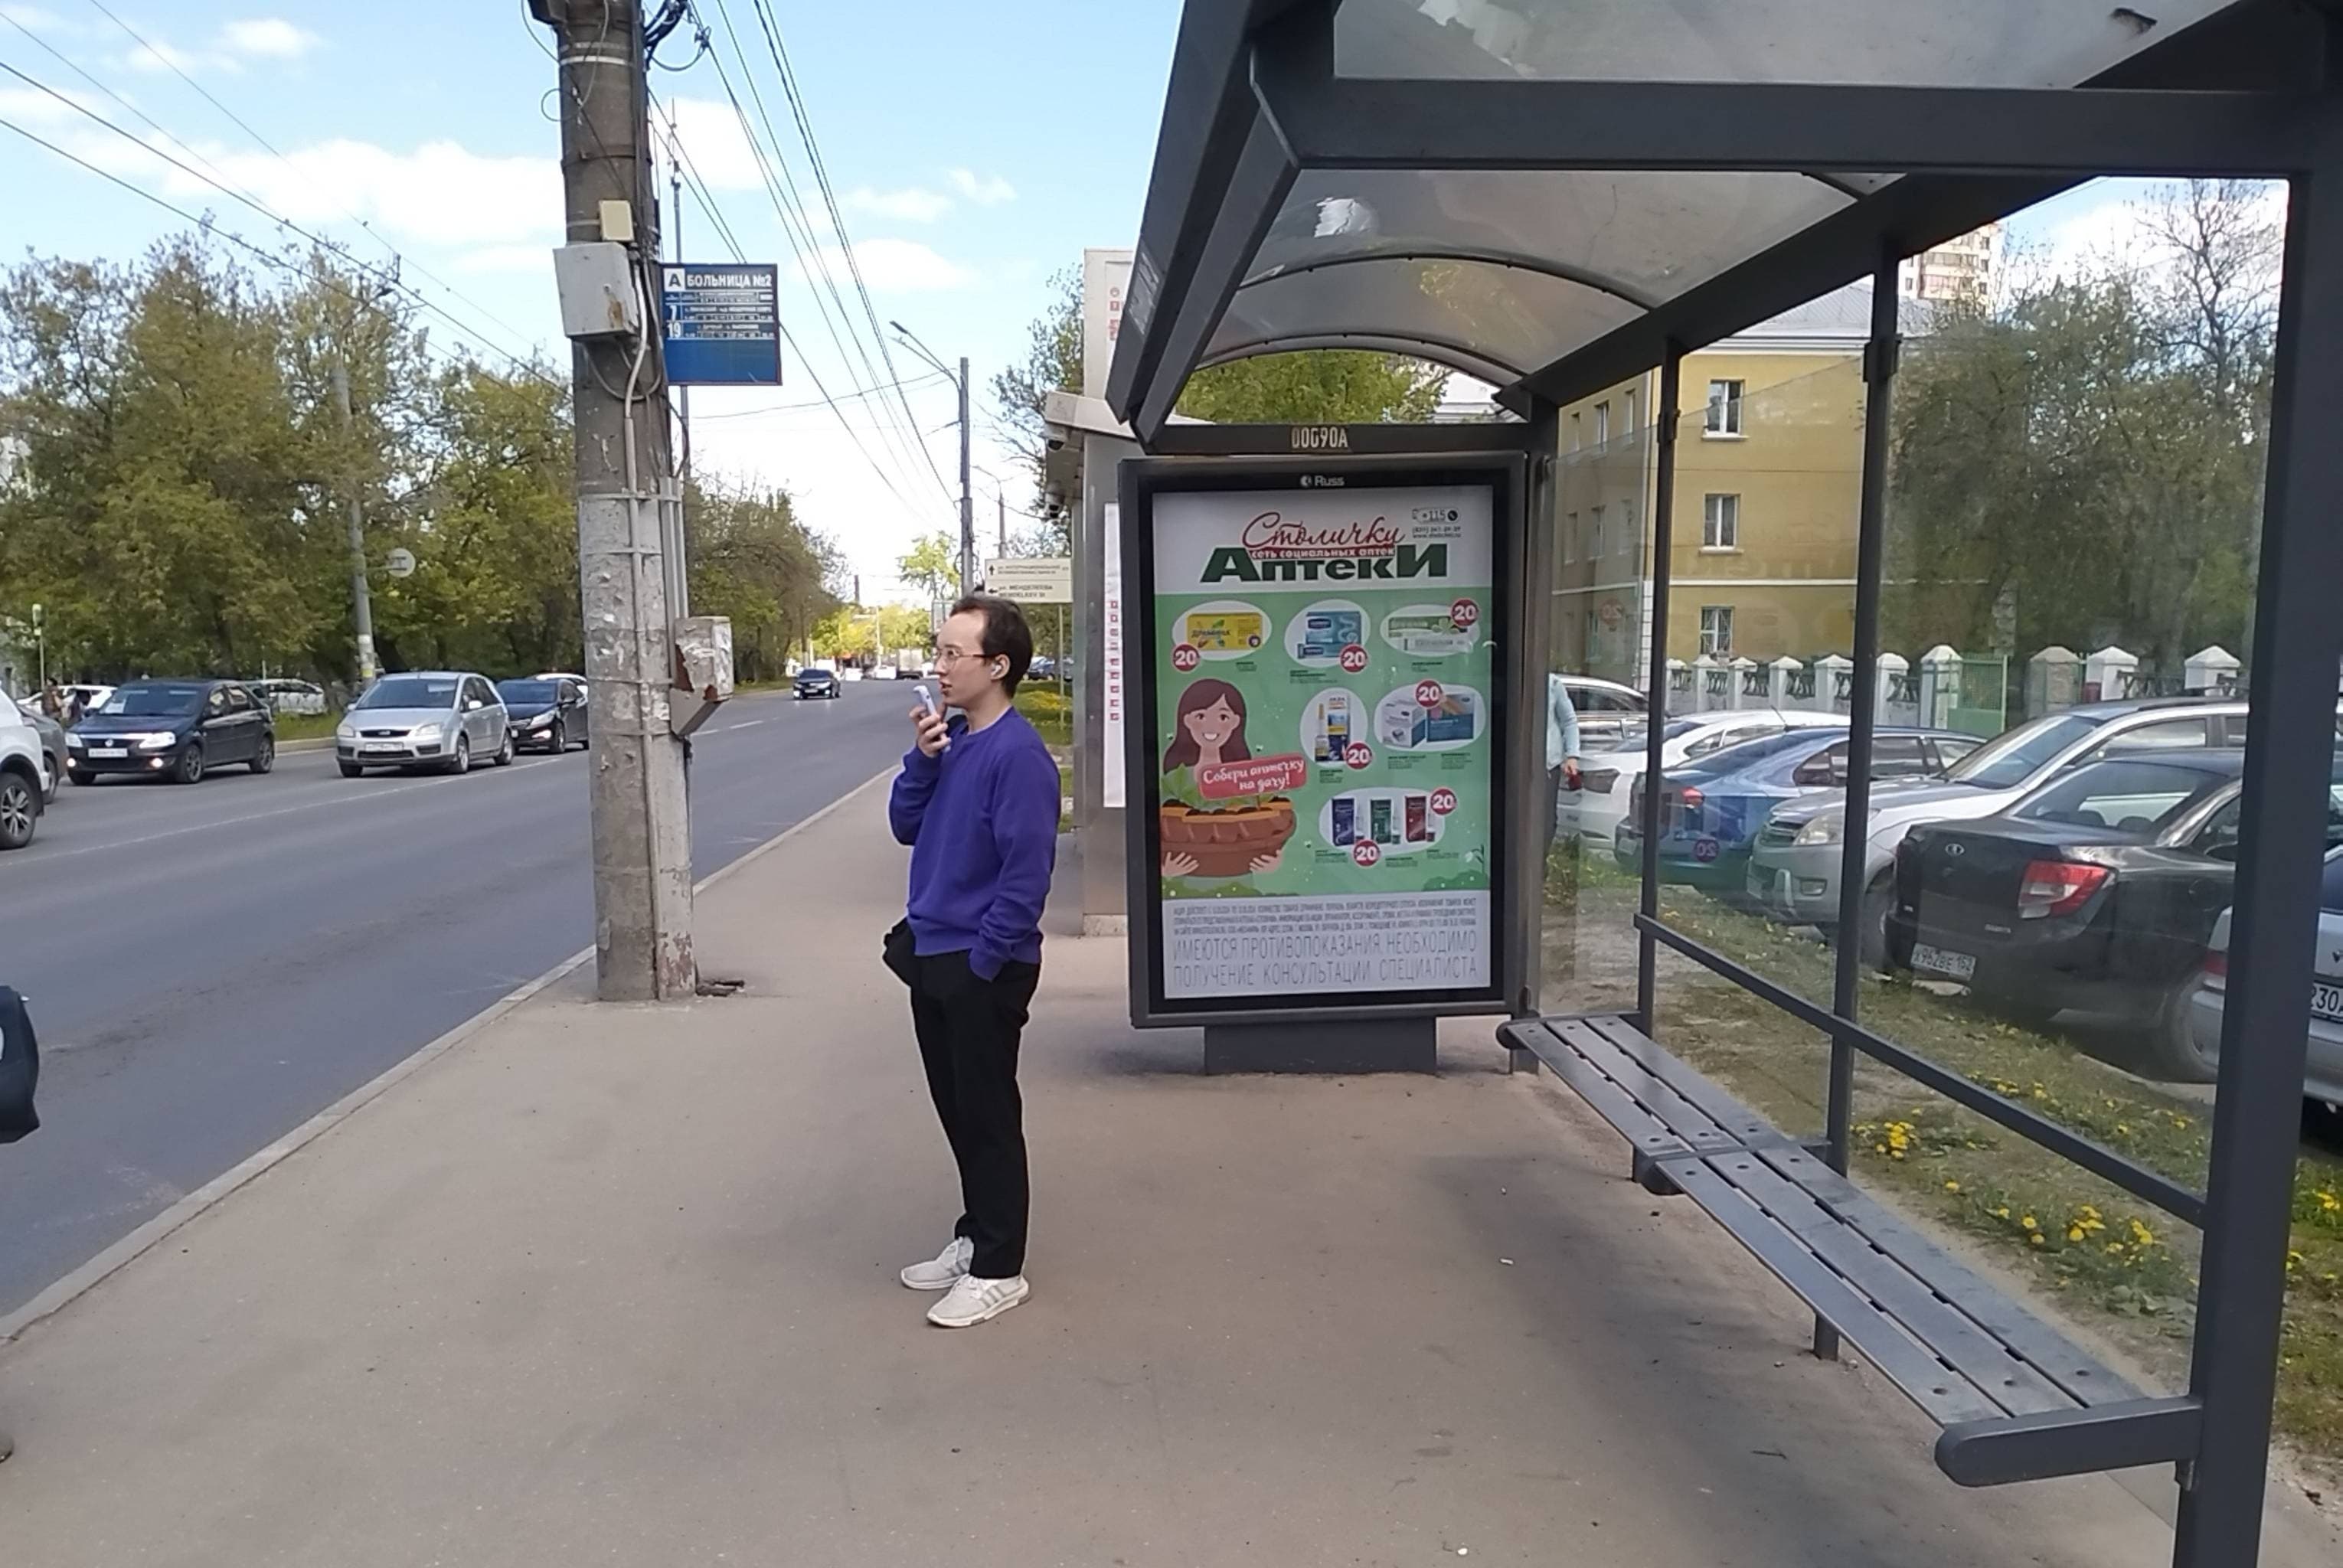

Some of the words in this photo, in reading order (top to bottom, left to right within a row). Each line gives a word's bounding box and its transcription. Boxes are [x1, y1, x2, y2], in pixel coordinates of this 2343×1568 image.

[687, 274, 750, 288] БОЛЬНИЦА
[753, 273, 773, 287] №2
[669, 305, 678, 320] 7
[668, 322, 681, 338] 19
[1315, 475, 1345, 487] Russ
[1242, 511, 1406, 548] Столички
[1252, 549, 1276, 560] сеть
[1279, 547, 1355, 560] социальных
[1359, 547, 1395, 558] аптек
[1454, 604, 1478, 622] 20
[1175, 649, 1198, 666] 20
[1342, 650, 1367, 668] 20
[1417, 685, 1441, 702] 20
[1347, 747, 1371, 765] 20
[1202, 766, 1249, 785] Собери
[1250, 759, 1305, 776] аптечку
[1239, 779, 1256, 791] на
[1256, 771, 1291, 793] дачу!
[1432, 793, 1456, 810] 20
[1354, 845, 1378, 861] 20
[1173, 937, 1238, 961] ИМЕЮТСЯ
[1387, 929, 1478, 956] НЕОБХОДИМО
[1173, 962, 1254, 988] ПОЛУЧЕНИЕ
[1263, 959, 1371, 985] КОНСУЛЬТАЦИИ
[1380, 955, 1477, 982] СПЕЦИАЛИСТА
